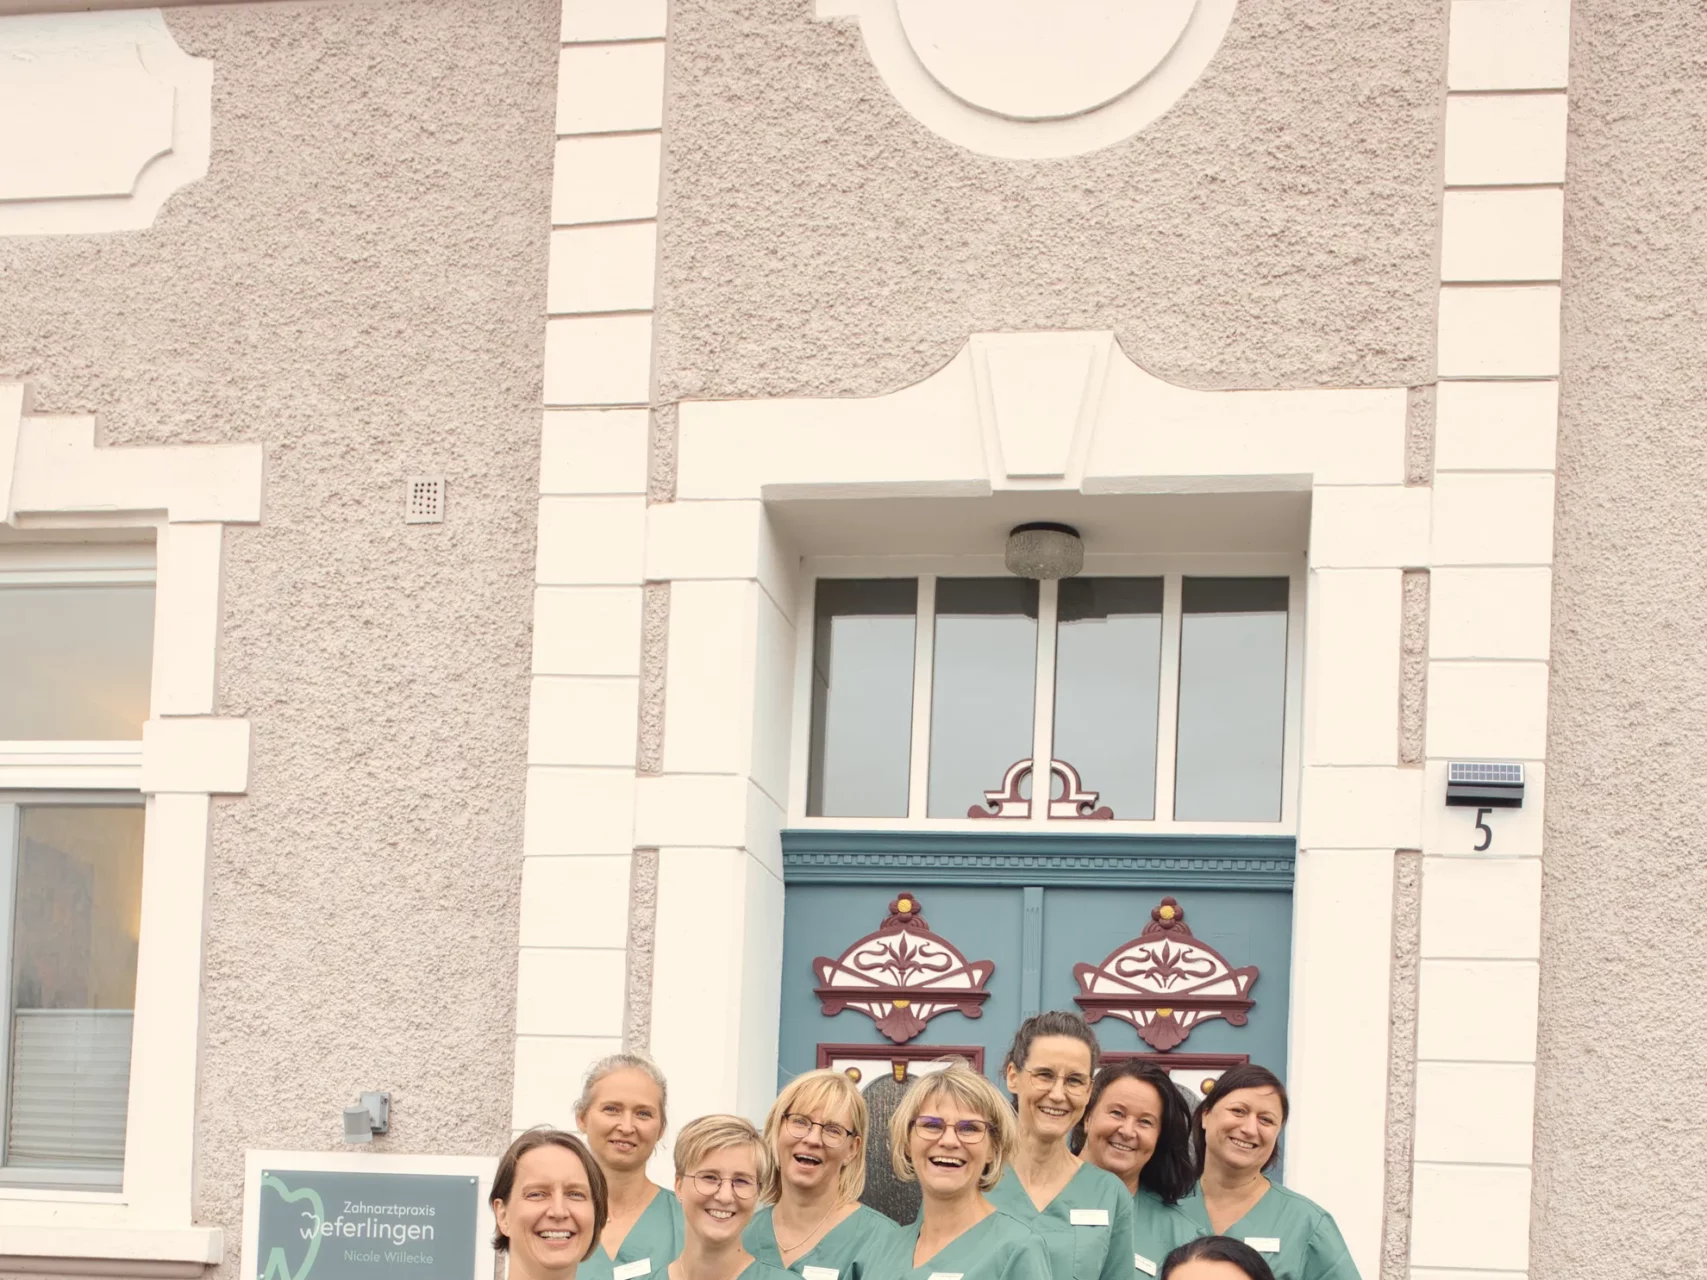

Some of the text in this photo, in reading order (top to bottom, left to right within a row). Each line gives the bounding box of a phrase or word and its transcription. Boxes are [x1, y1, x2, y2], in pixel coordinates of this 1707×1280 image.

[1473, 808, 1493, 851] 5
[343, 1200, 436, 1218] Zahnarztpraxis
[344, 1250, 434, 1265] Nicole Willecke
